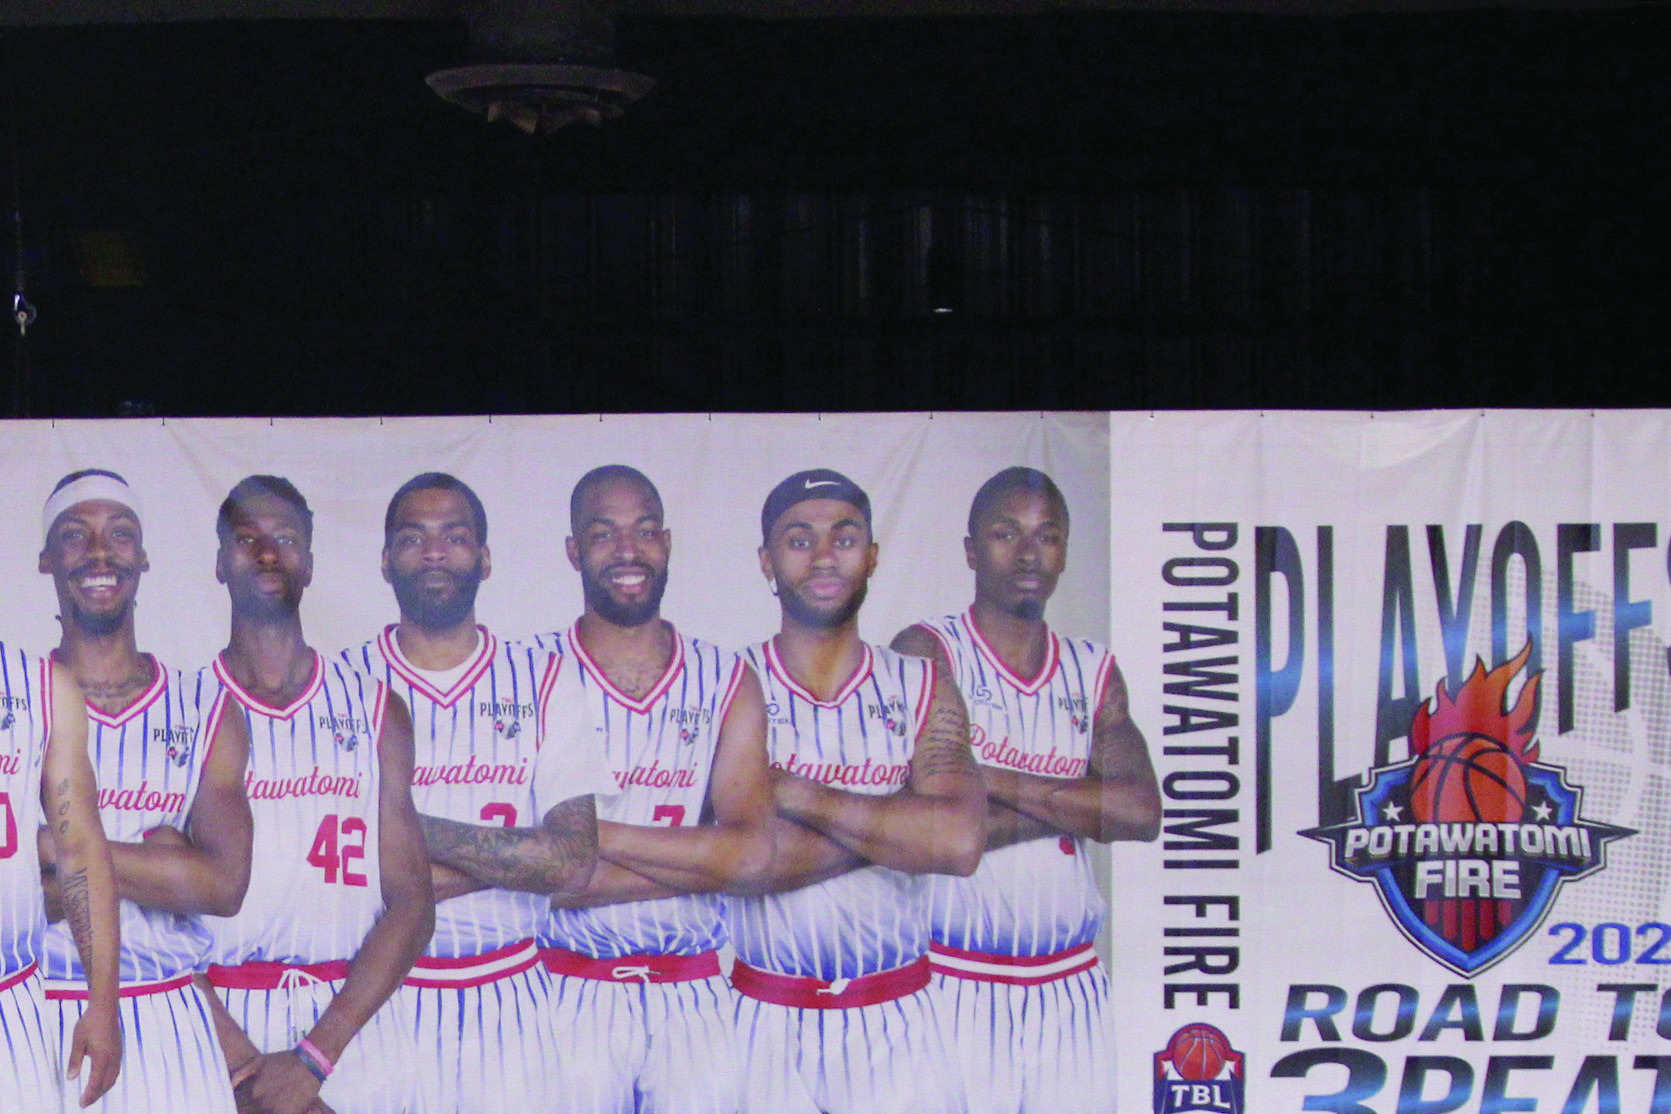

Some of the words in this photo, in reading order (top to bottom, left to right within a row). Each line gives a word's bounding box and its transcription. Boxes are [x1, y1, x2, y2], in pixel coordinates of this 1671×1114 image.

[1161, 522, 1241, 870] POTAWATOMI
[1254, 520, 1671, 855] PLAYOFF
[306, 813, 368, 888] 42
[1344, 823, 1592, 860] POTAWATOMI
[1414, 858, 1523, 899] FIRE
[1162, 894, 1240, 1010] FIRE
[1278, 983, 1561, 1043] ROAD
[1596, 983, 1671, 1042] T
[1171, 1084, 1232, 1110] TBL
